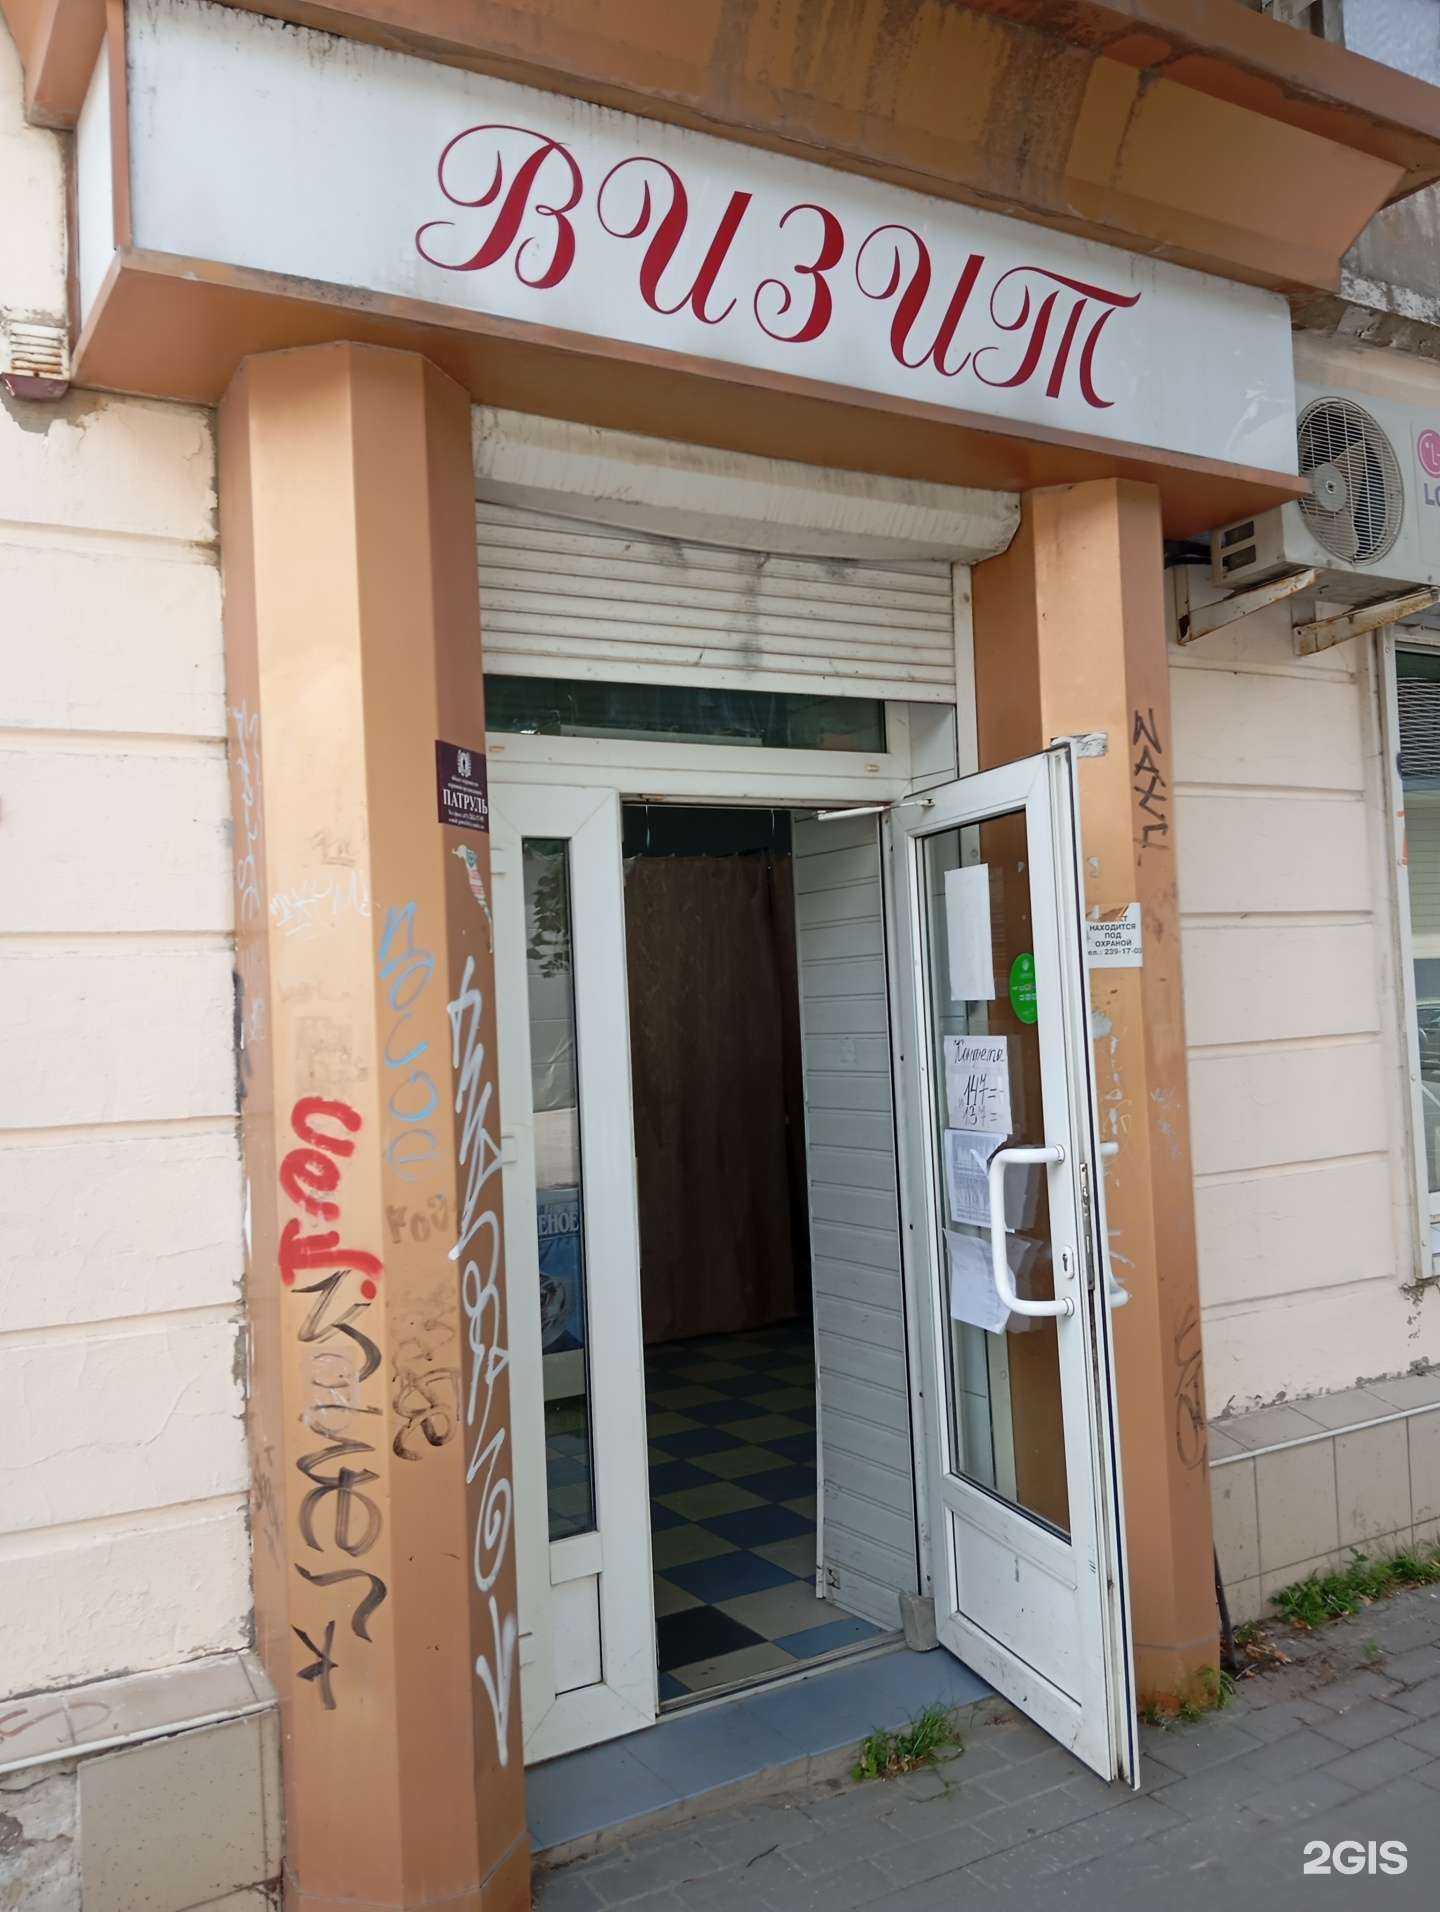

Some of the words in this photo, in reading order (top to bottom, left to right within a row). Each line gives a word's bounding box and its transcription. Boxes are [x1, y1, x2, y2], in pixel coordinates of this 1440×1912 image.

[415, 124, 1142, 409] ВИЗИТ
[443, 788, 488, 814] ПАТРУЛЬ
[1089, 923, 1136, 931] НАХОДИТСЯ
